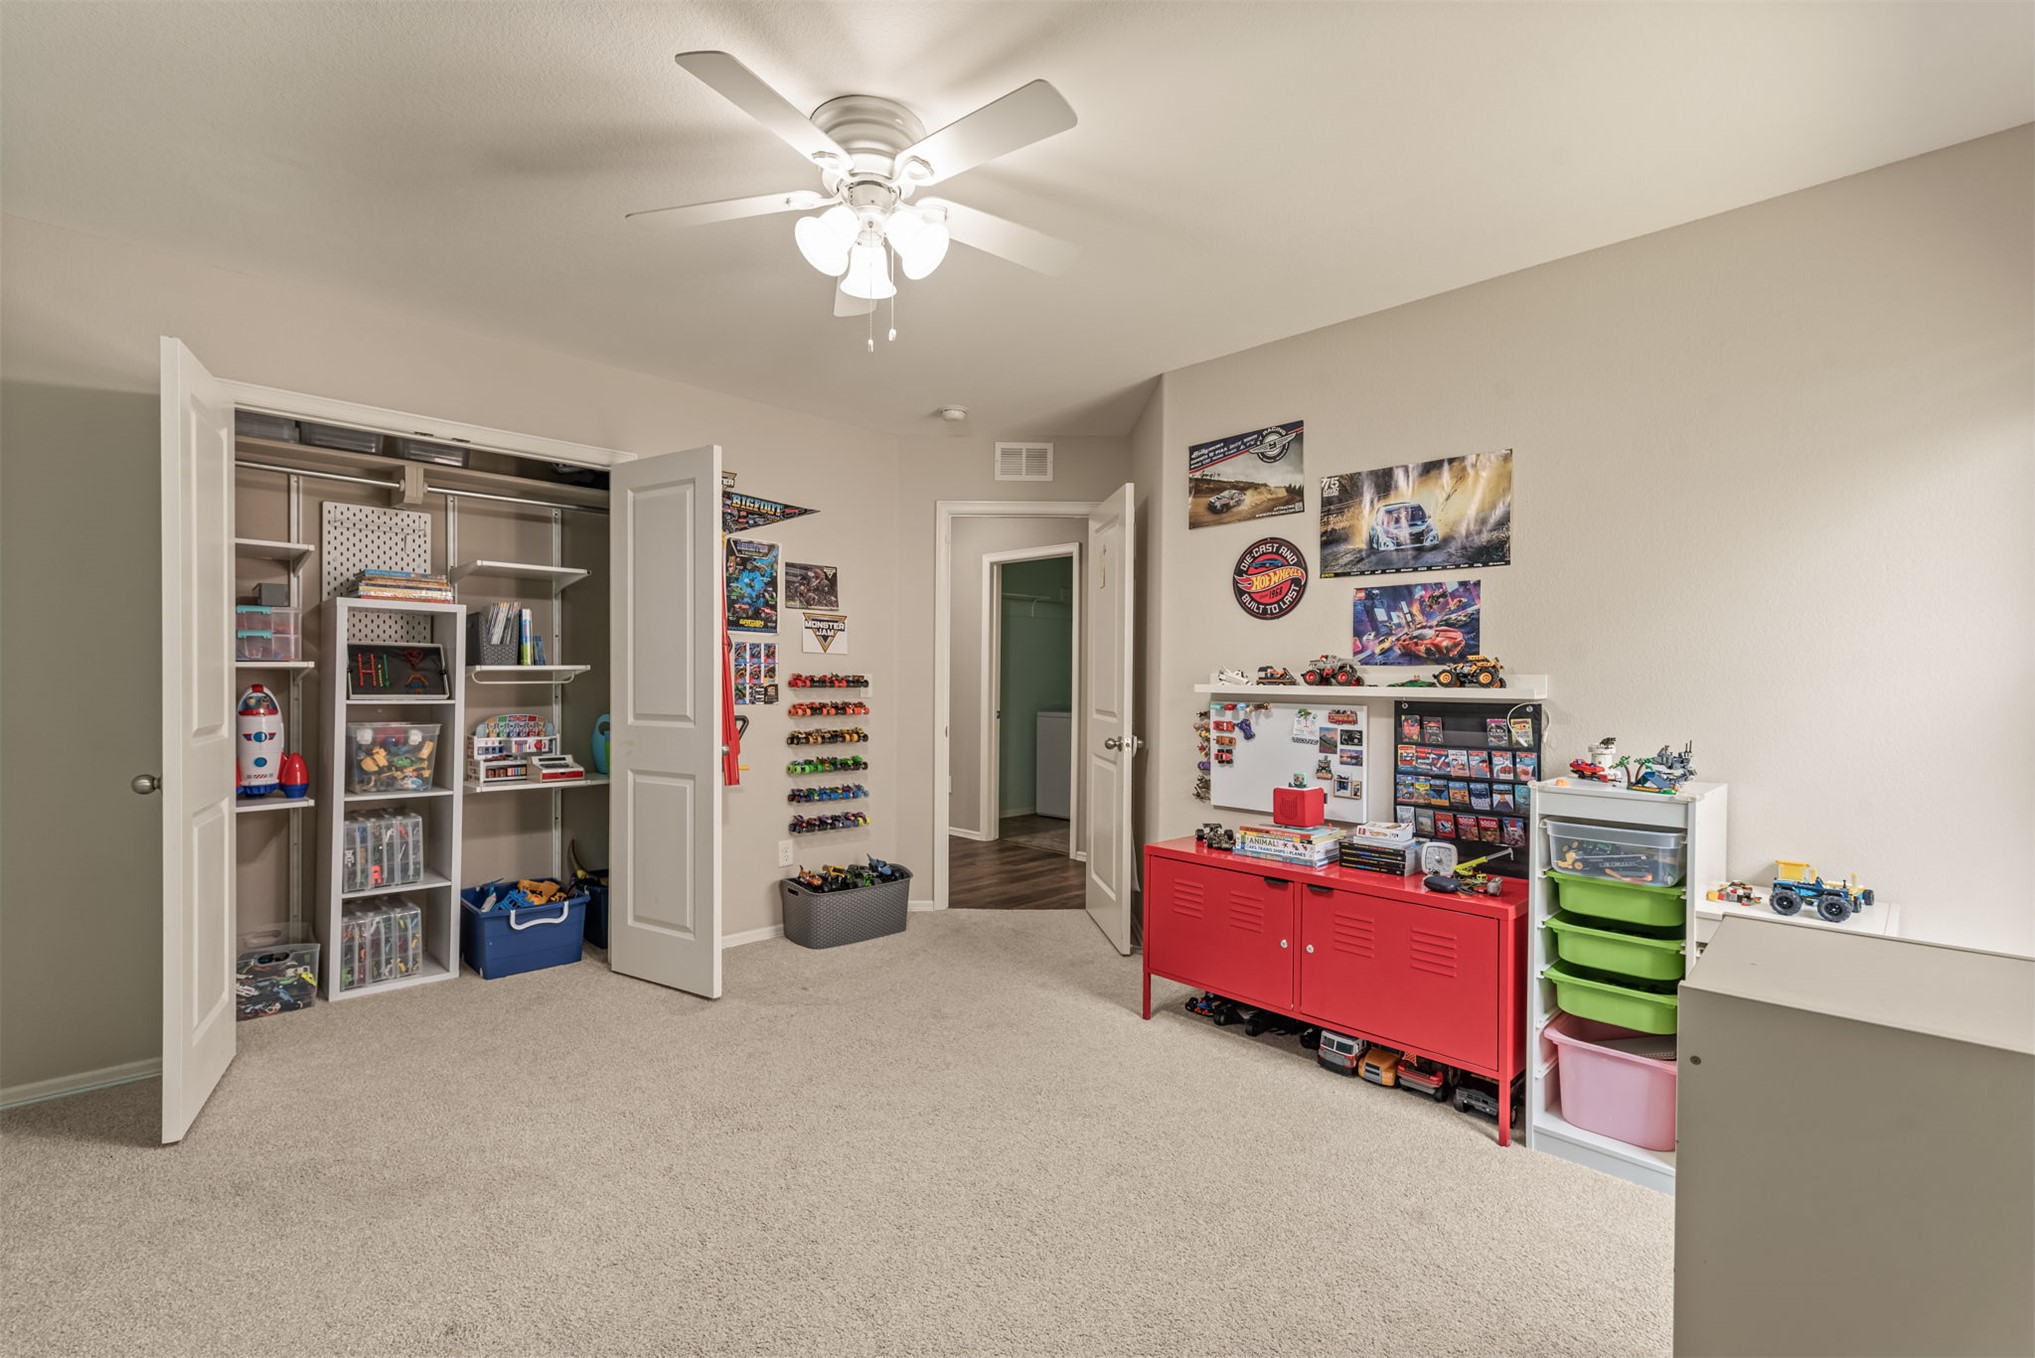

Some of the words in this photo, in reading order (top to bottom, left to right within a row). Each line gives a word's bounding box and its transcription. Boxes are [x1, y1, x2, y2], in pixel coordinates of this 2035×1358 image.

[1262, 426, 1287, 436] RACING
[731, 494, 785, 516] BIGFOOT
[1278, 545, 1298, 565] AND
[1241, 593, 1265, 614] BUILT
[1266, 604, 1280, 614] TO
[1280, 583, 1300, 609] LAST
[1268, 586, 1284, 600] 1968
[804, 620, 845, 631] MONSTER
[816, 628, 835, 637] JAM
[1249, 837, 1277, 847] ANIMAL
